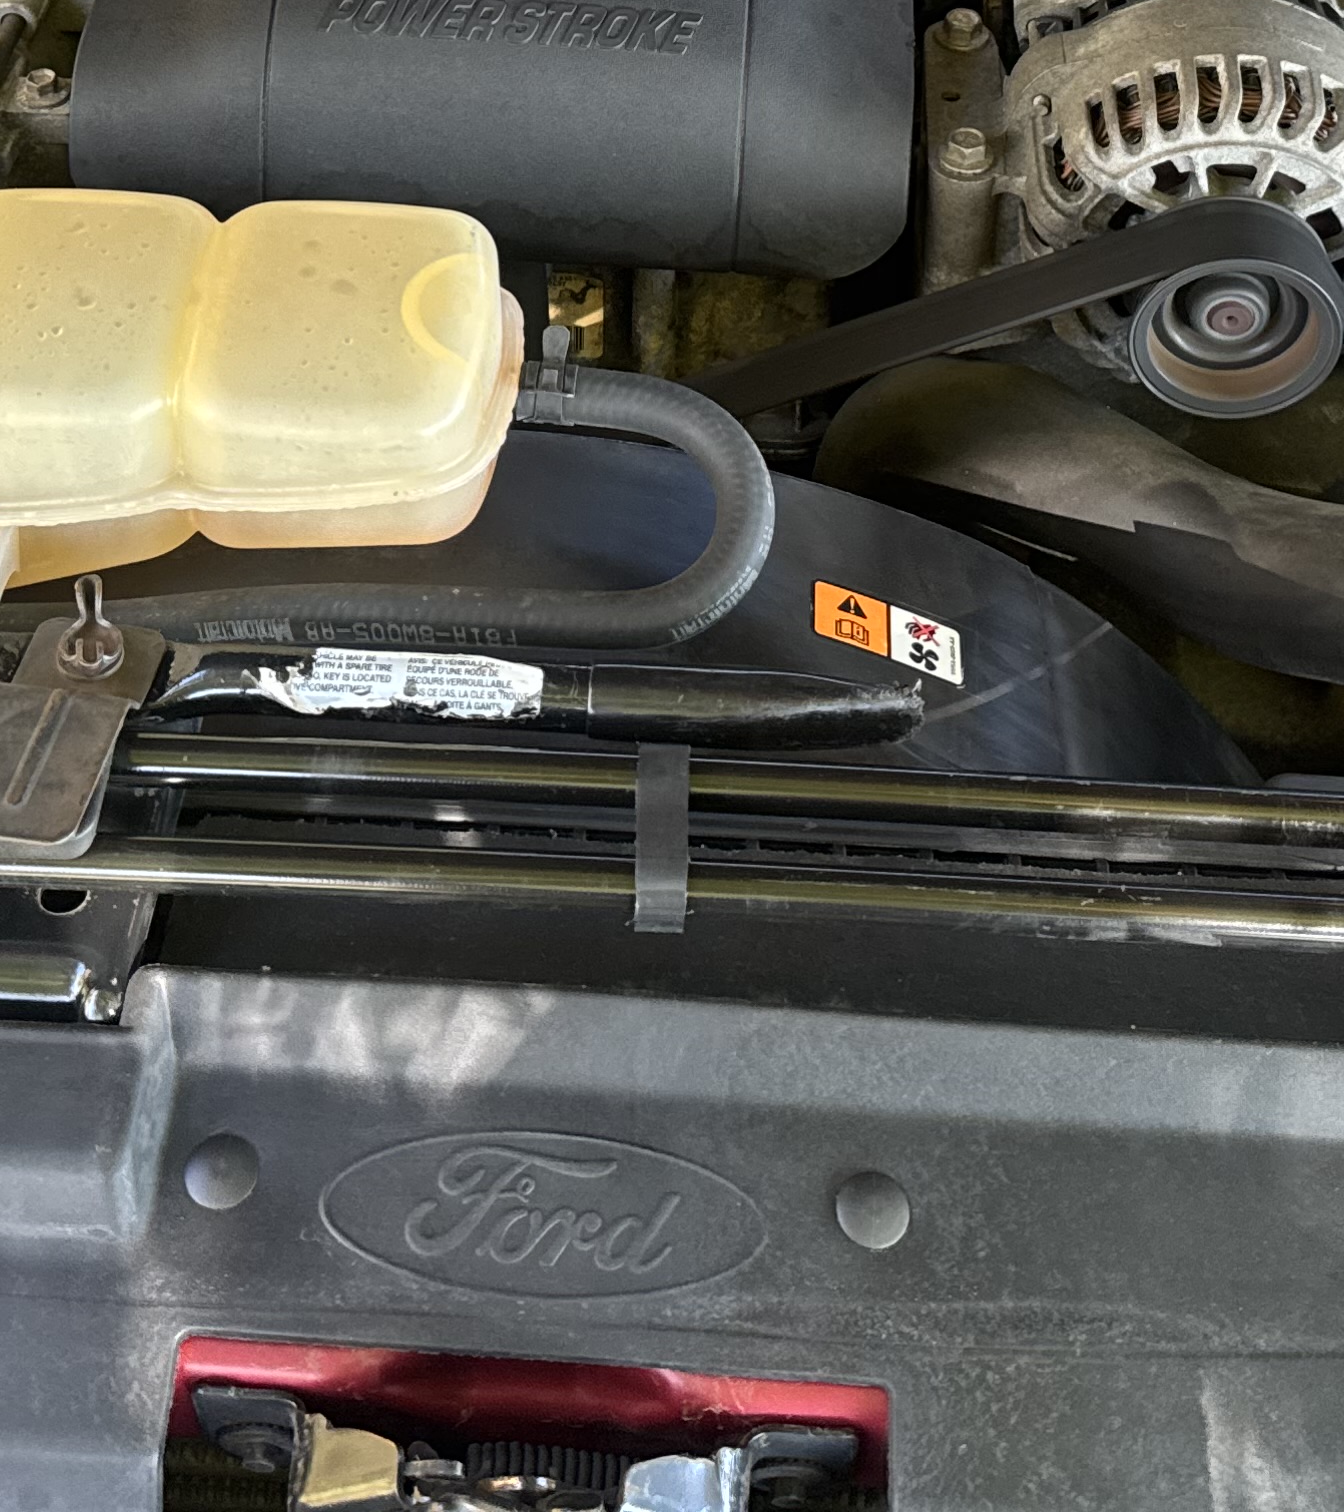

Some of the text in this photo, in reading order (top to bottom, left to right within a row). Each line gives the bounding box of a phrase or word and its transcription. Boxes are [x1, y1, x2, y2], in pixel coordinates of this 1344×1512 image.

[345, 663, 372, 671] SPARE
[376, 664, 392, 672] TIRE
[489, 668, 499, 677] DE
[324, 672, 340, 680] KEY
[342, 673, 350, 681] IS
[352, 674, 392, 683] LOCATED
[427, 688, 437, 697] CE
[458, 689, 468, 698] LA
[471, 688, 484, 699] CLÉ
[487, 691, 496, 699] SE
[405, 1145, 680, 1273] Ford
